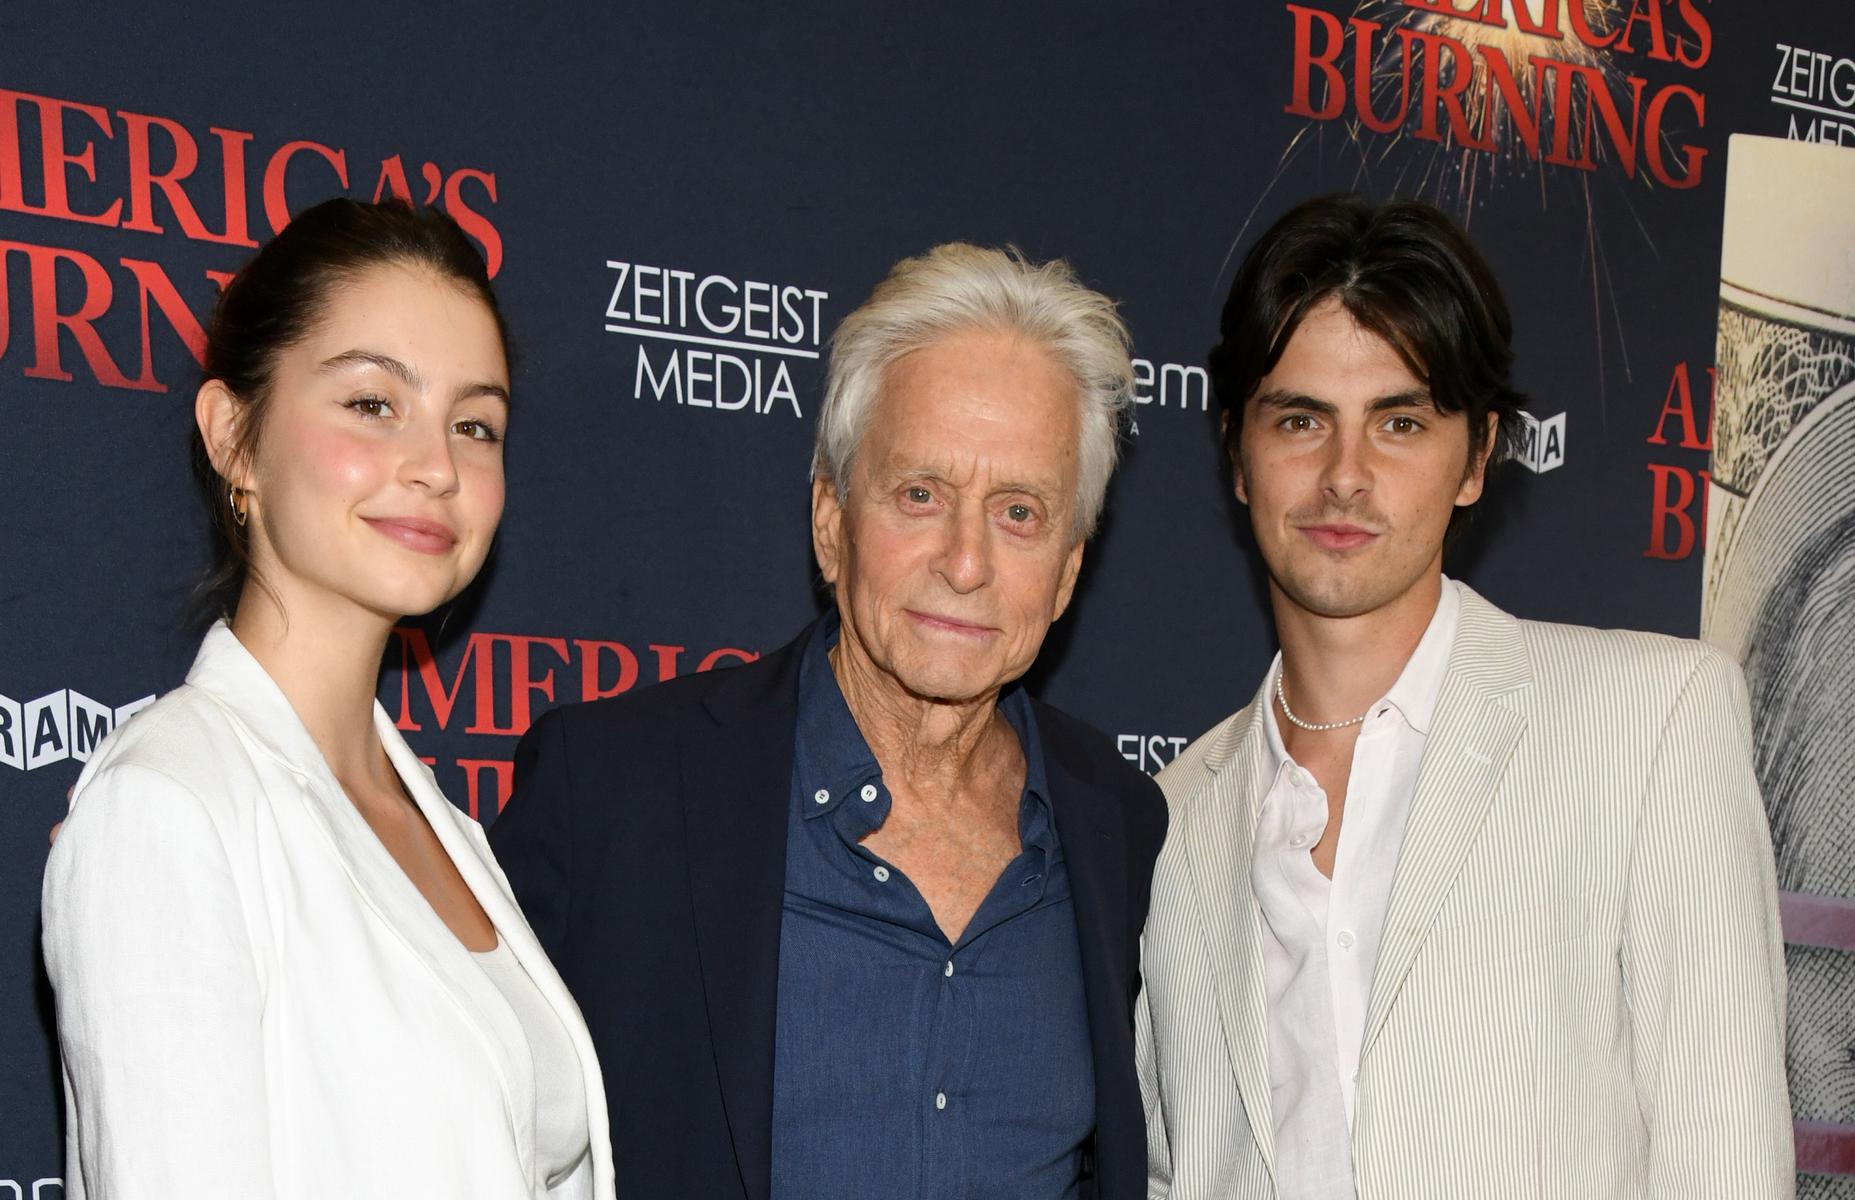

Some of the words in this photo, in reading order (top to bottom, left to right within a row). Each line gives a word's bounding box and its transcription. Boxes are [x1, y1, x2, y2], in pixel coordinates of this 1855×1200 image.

[1284, 4, 1708, 190] BURNING
[606, 260, 829, 346] ZEITGEIST
[634, 344, 803, 419] MEDIA
[1647, 360, 1717, 451] A
[1643, 463, 1712, 561] B
